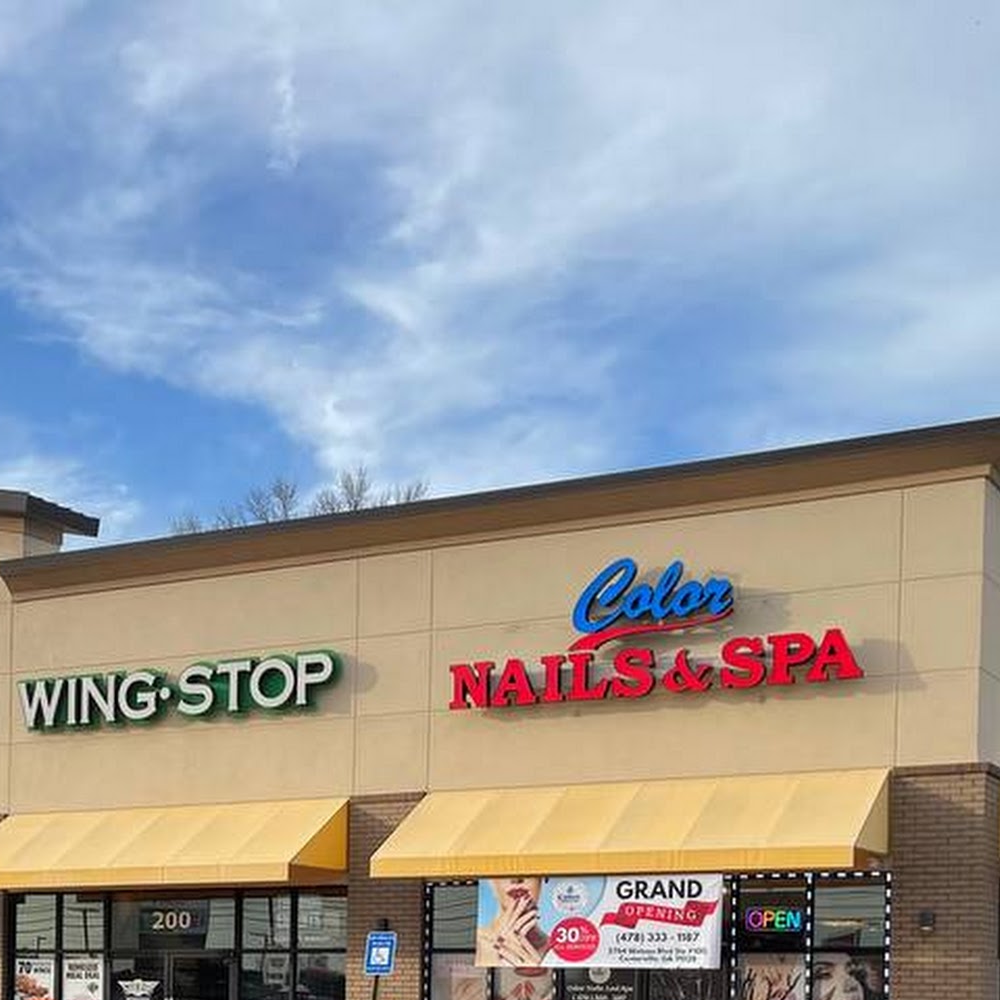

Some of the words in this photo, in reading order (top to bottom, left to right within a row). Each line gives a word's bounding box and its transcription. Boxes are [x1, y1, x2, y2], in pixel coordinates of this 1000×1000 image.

[571, 557, 734, 634] Color
[449, 647, 656, 710] NAILS
[662, 649, 714, 693] &
[720, 628, 865, 688] SPA
[616, 879, 703, 900] GRAND
[152, 911, 191, 930] 200
[624, 905, 698, 922] OPENING
[749, 910, 801, 930] OPEN
[616, 933, 645, 944] (478)
[647, 932, 668, 943] 333
